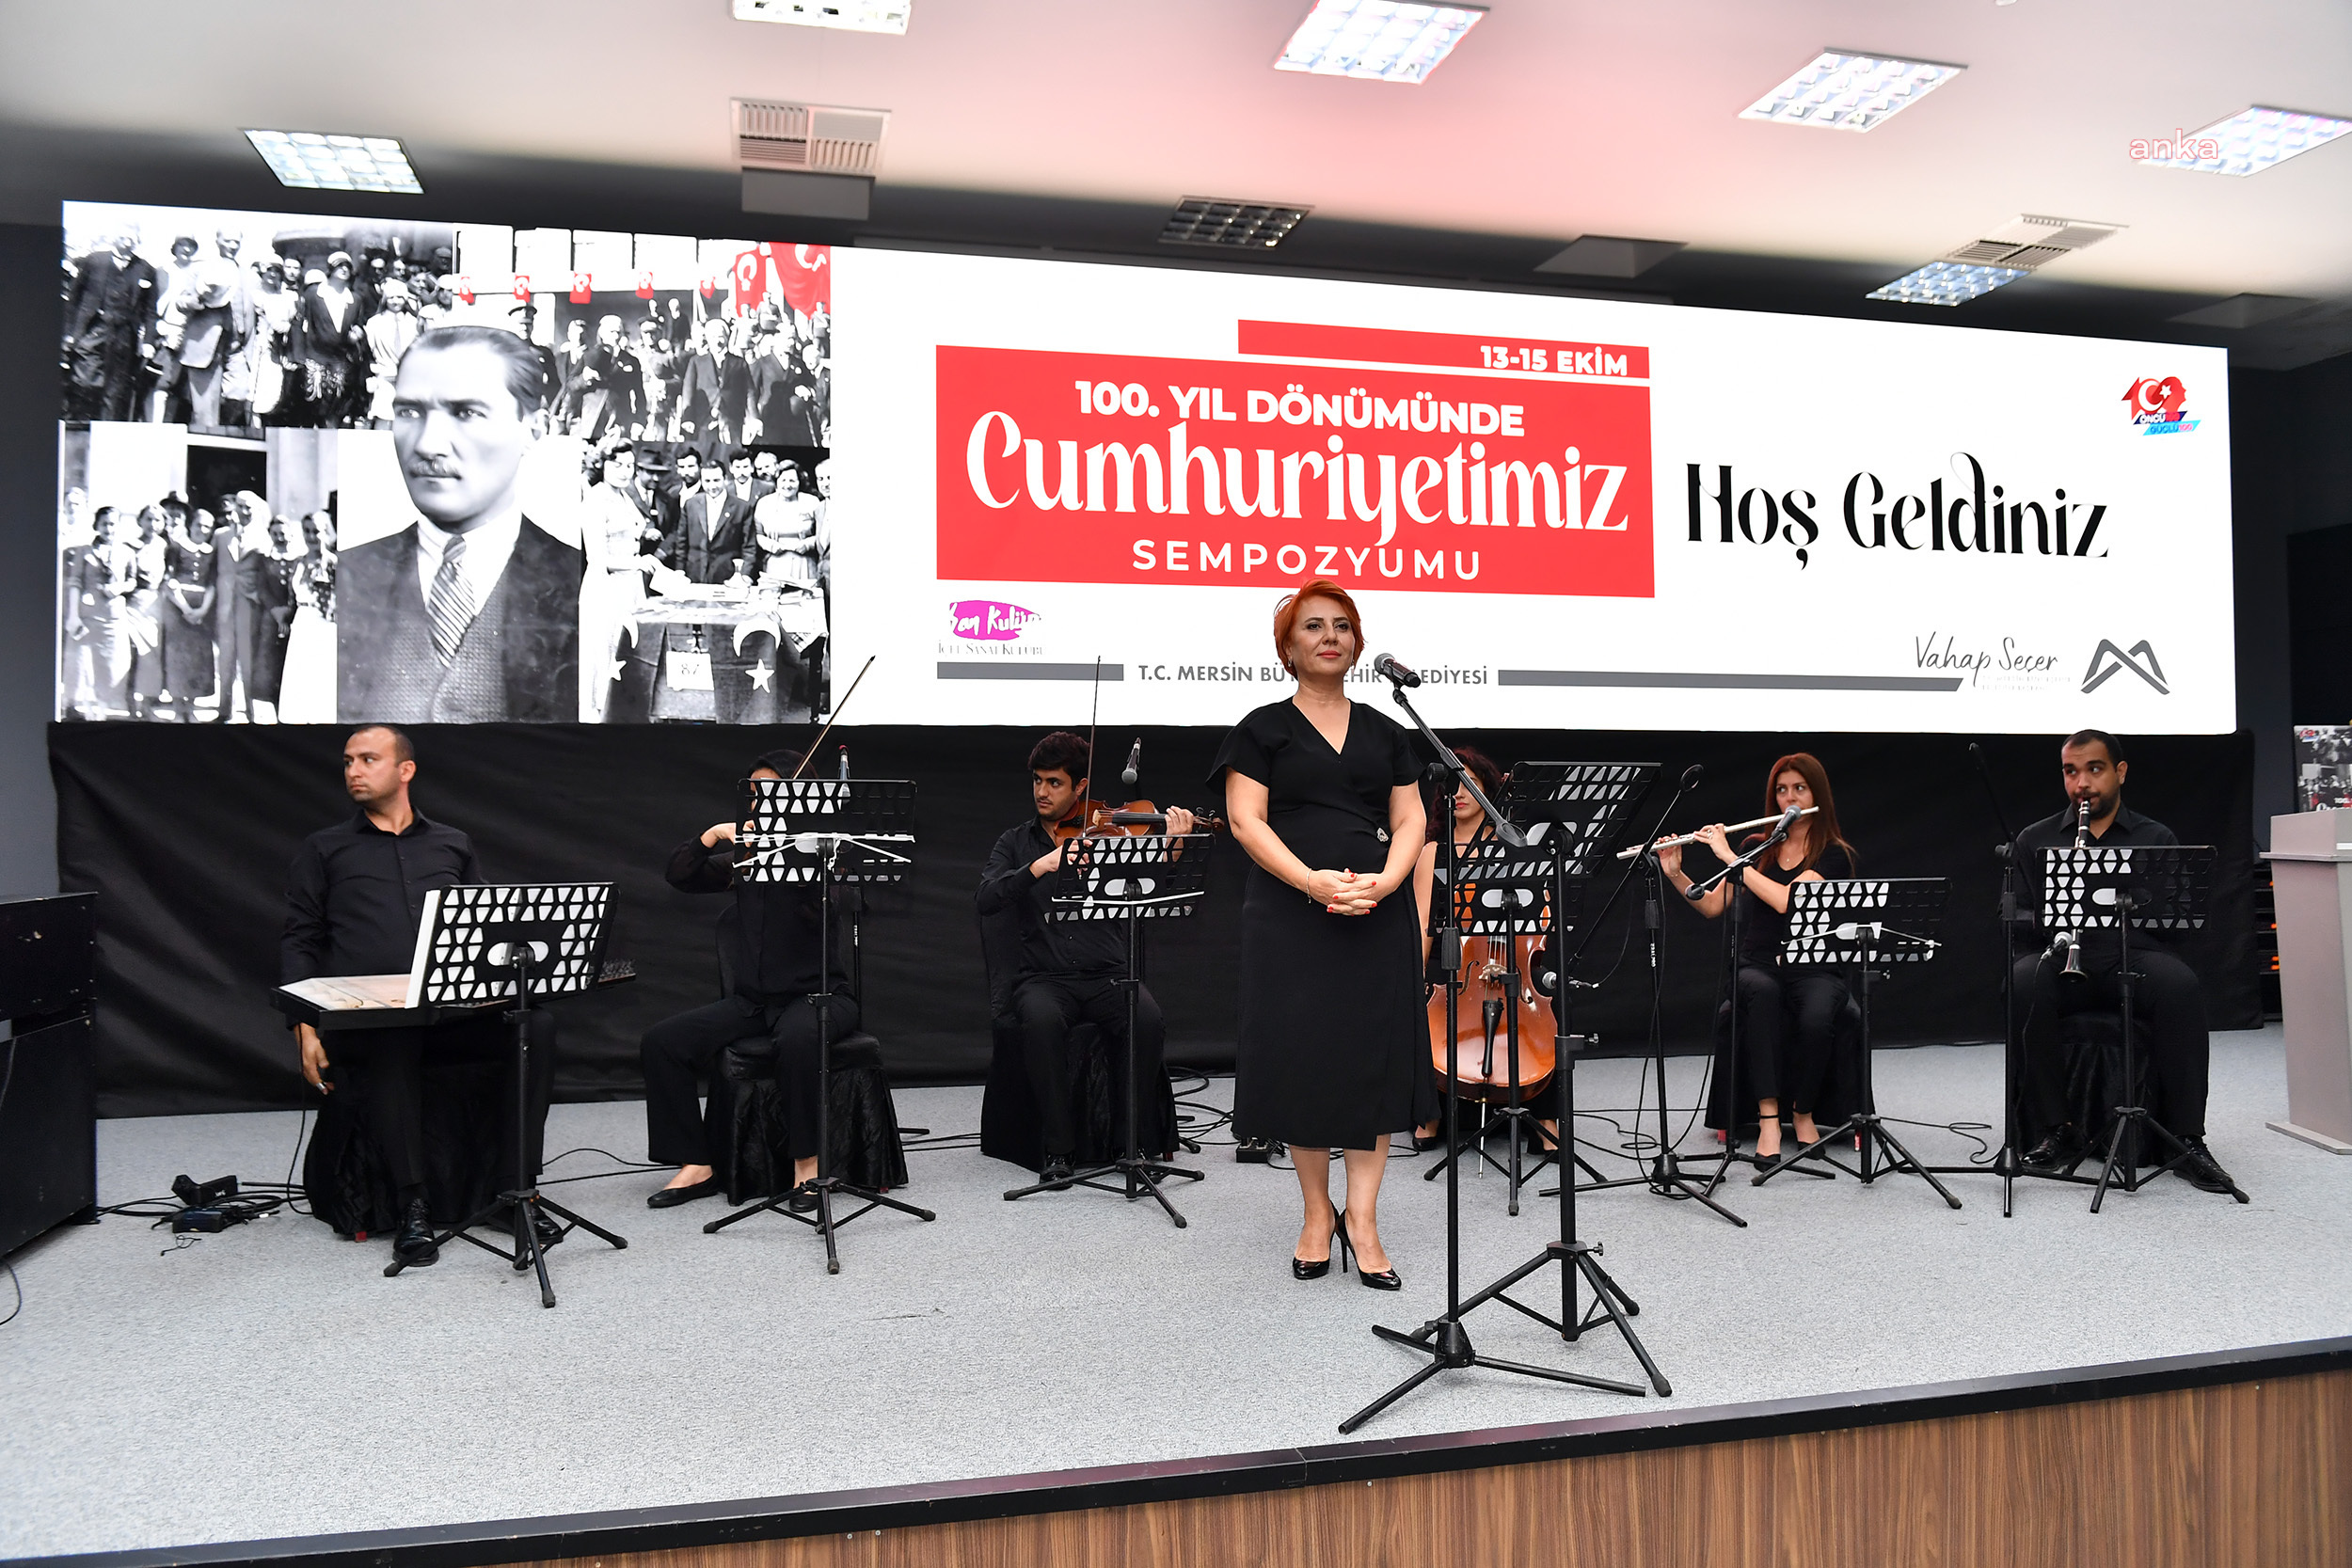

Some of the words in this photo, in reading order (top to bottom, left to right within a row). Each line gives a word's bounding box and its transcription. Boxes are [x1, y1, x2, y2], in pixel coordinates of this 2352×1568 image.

[1480, 345, 1548, 372] 13-15
[1557, 345, 1628, 376] EKİM
[1074, 380, 1160, 418] 100.
[1168, 385, 1237, 421] YIL
[1247, 383, 1525, 437] DÖNÜMÜNDE
[966, 410, 1629, 546] Cumhuriyetimiz
[1686, 463, 1820, 571] Hoş
[1843, 451, 2108, 558] Geldiniz
[1132, 539, 1479, 580] SEMPOZYUMU
[1137, 664, 1171, 681] T.C.
[1177, 660, 1253, 682] MERSİN
[1915, 631, 1992, 687] Vahap
[1998, 636, 2058, 673] Seçer
